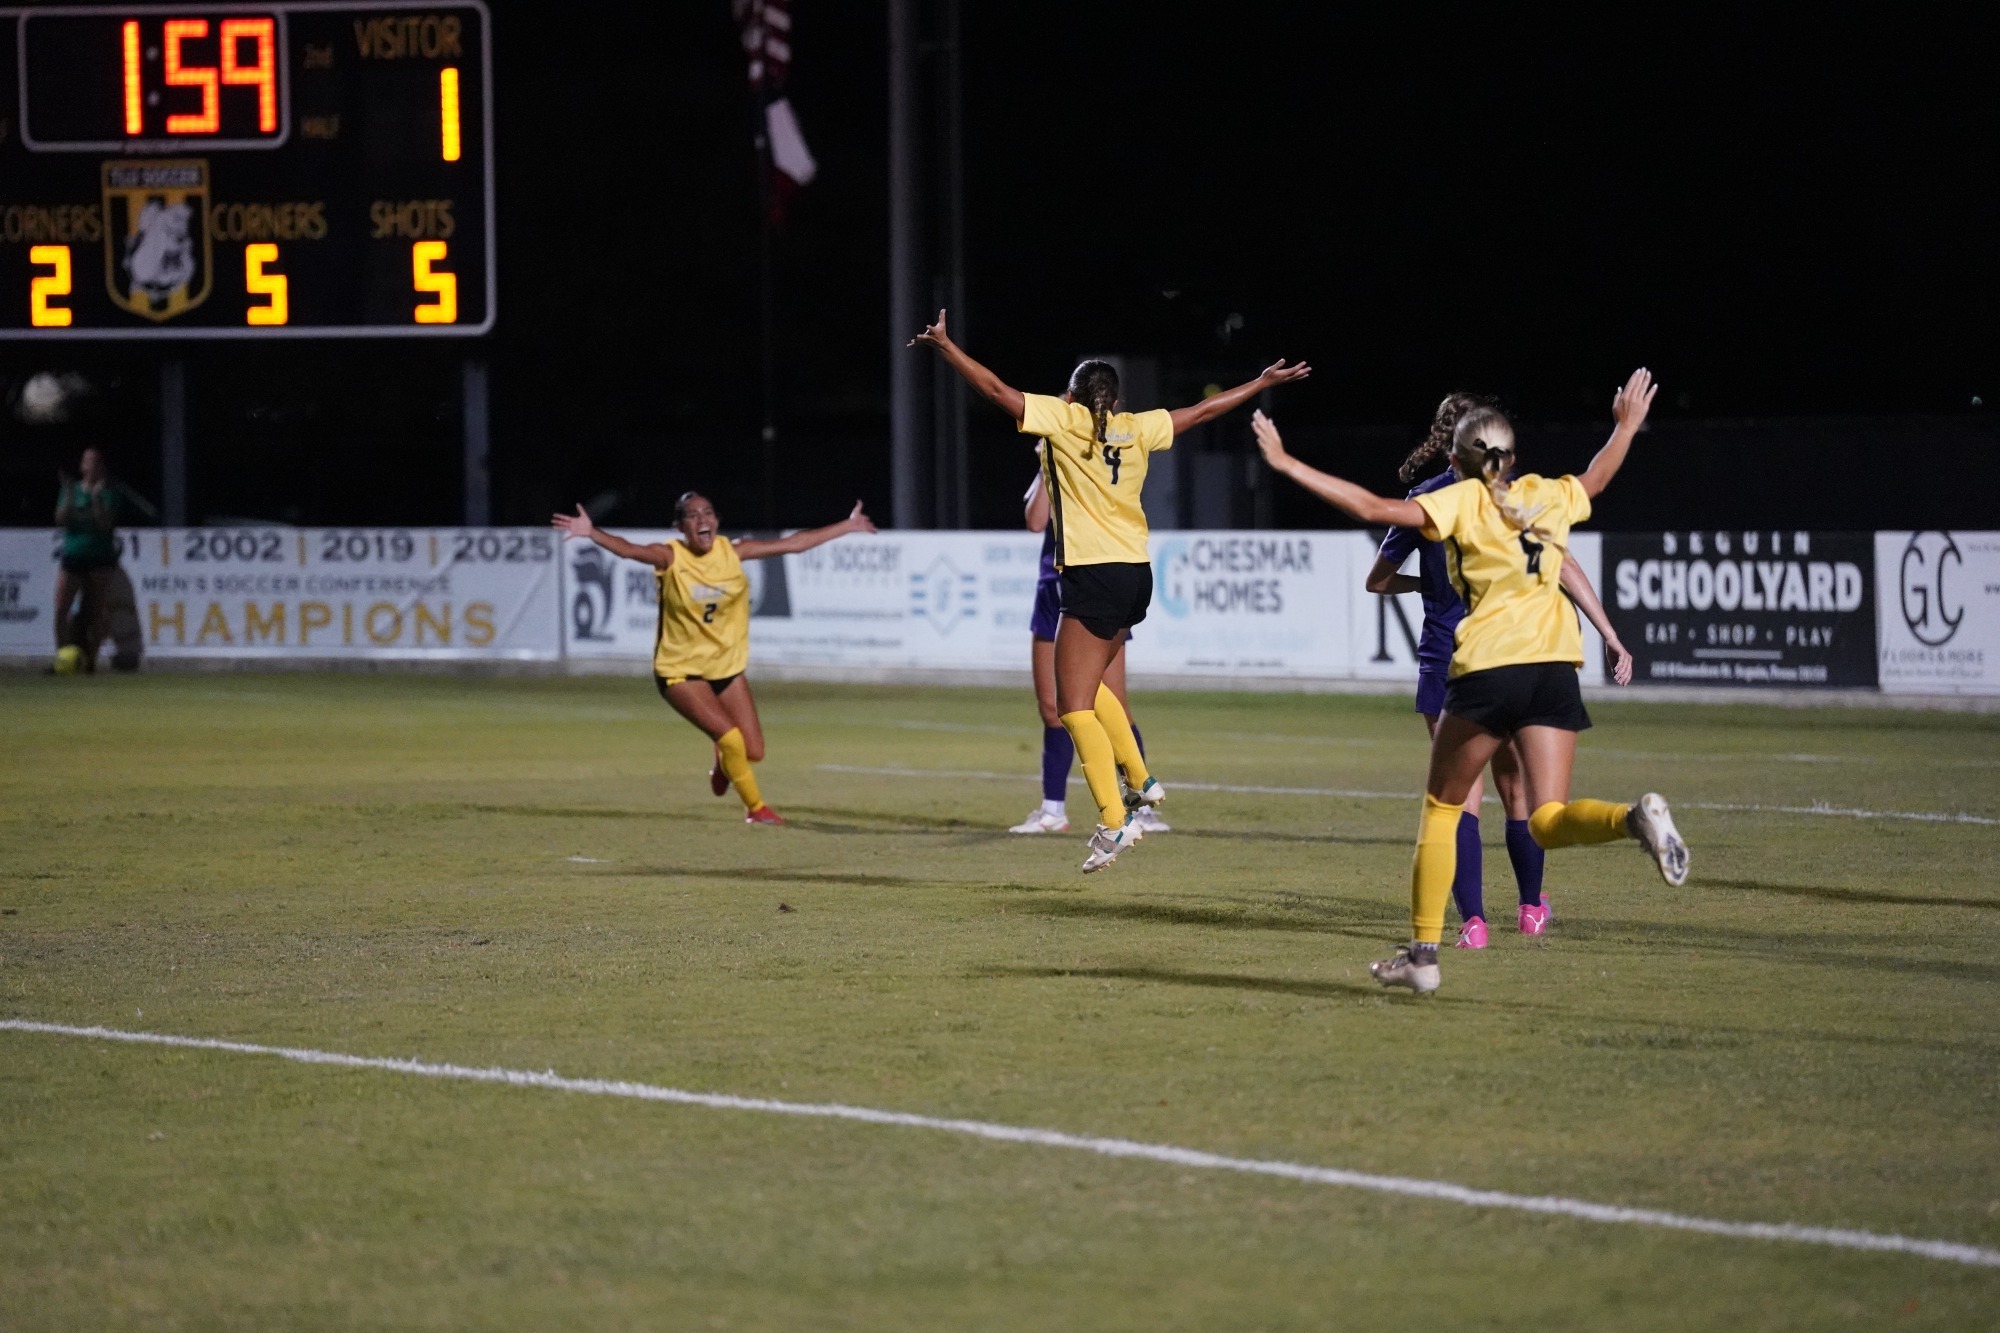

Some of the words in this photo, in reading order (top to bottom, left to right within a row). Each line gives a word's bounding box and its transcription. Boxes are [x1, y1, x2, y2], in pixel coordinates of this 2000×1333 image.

[353, 15, 463, 59] VISITOR
[123, 18, 277, 134] 1:59
[440, 67, 461, 162] 1
[212, 201, 327, 240] CORNERS
[370, 200, 455, 239] SHOTS
[30, 245, 72, 327] 2
[245, 243, 288, 325] 5
[413, 241, 457, 324] 5
[1103, 444, 1121, 485] 4
[185, 530, 283, 562] 2002
[322, 530, 413, 562] 2019
[453, 530, 553, 562] 2025
[1192, 539, 1314, 572] CHESMAR
[213, 576, 299, 593] SOCCER
[1193, 579, 1284, 613] HOMES
[1615, 559, 1863, 612] SCHOOLYARD
[150, 600, 497, 647] HAMPIONS
[703, 603, 717, 623] 2
[1645, 622, 1679, 644] EAT
[1706, 623, 1757, 645] SHOP
[1785, 625, 1833, 647] PLAY
